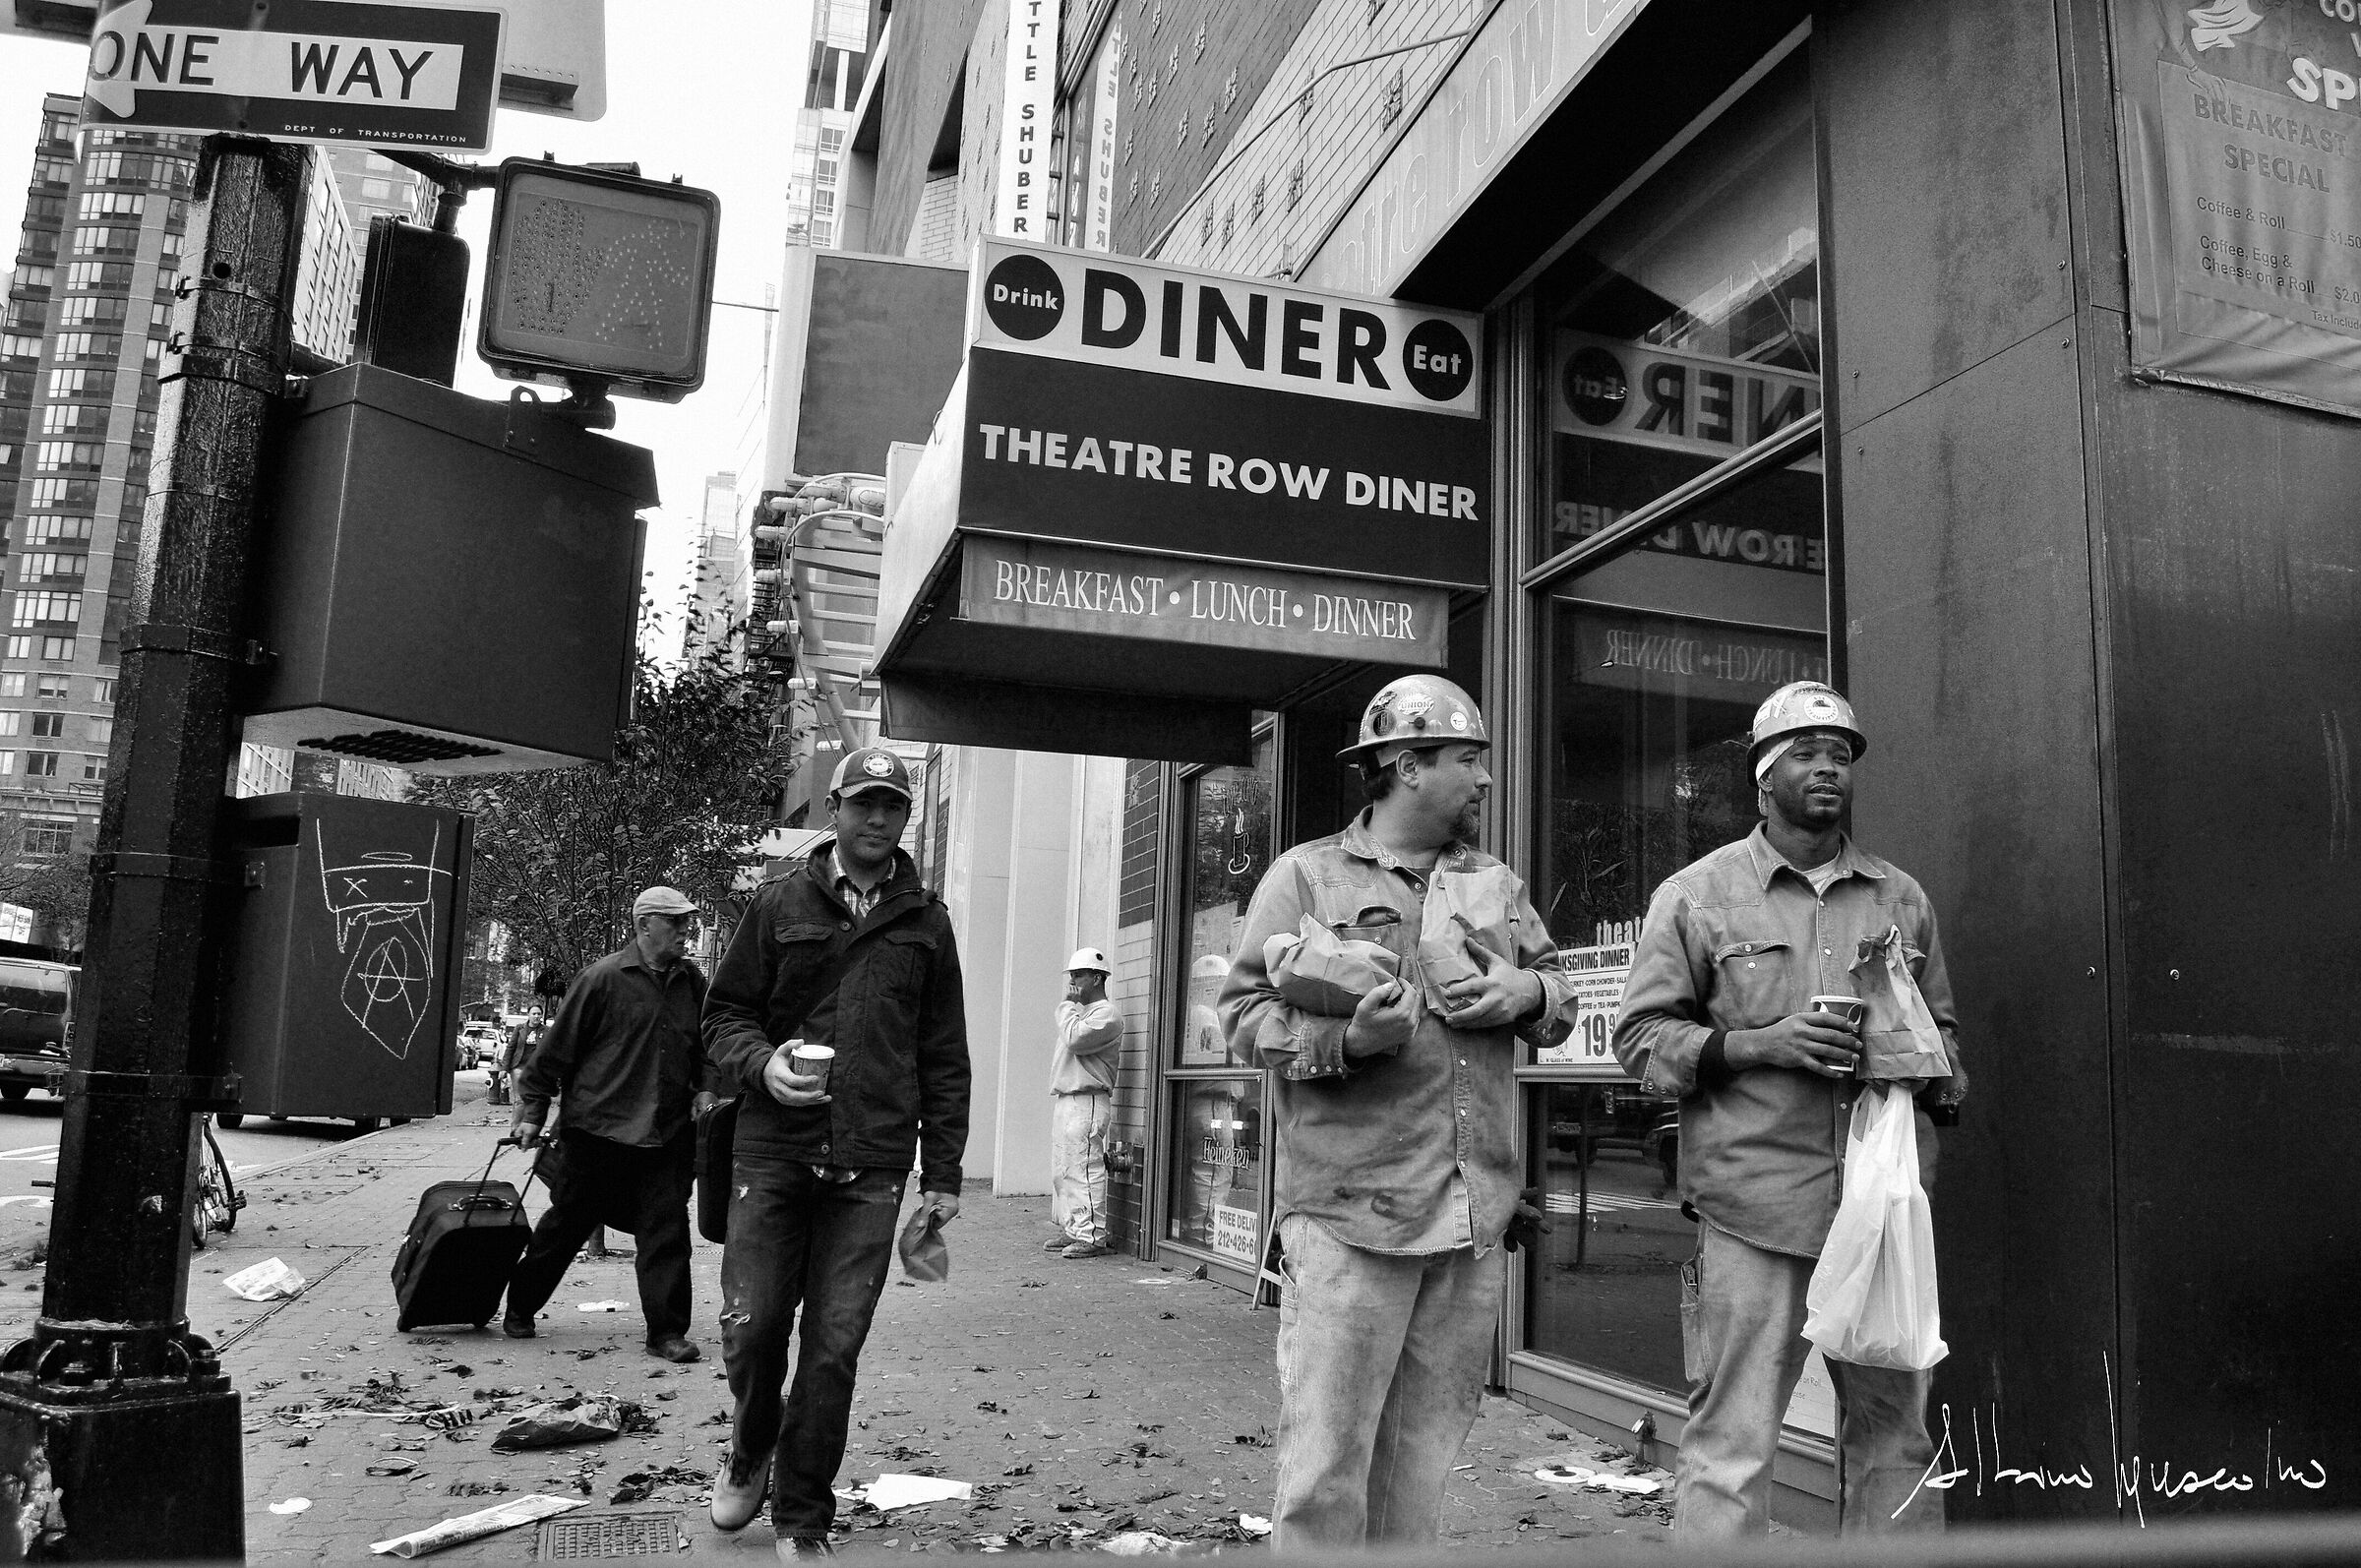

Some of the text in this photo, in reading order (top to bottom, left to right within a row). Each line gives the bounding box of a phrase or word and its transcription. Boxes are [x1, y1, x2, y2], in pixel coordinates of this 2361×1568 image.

[2320, 0, 2361, 25] CO
[90, 30, 434, 100] ONE WAY
[2286, 57, 2361, 111] SP
[284, 124, 316, 133] DEPT
[358, 129, 467, 143] TRANSPORTATION
[2194, 93, 2349, 157] BREAKFAST
[1013, 103, 1035, 232] SHUBER
[2223, 144, 2331, 194] SPECIAL
[2197, 196, 2241, 218] Coffee
[2245, 208, 2255, 222] &
[2260, 211, 2285, 229] Roll
[2253, 248, 2278, 269] Egg
[2282, 254, 2293, 269] &
[2202, 256, 2361, 305] Cheese on a Roll $2.0
[993, 268, 1463, 391] Drink DINER Eat
[2312, 310, 2361, 331] Tax Includ
[979, 423, 1480, 521] THEATRE ROW DINER
[994, 559, 1418, 641] BREAKFAST LUNCH DINNER
[1400, 700, 1430, 709] UNION
[1600, 948, 1630, 968] DINNER
[1202, 1136, 1251, 1170] Heineken
[1219, 1210, 1236, 1227] FREE
